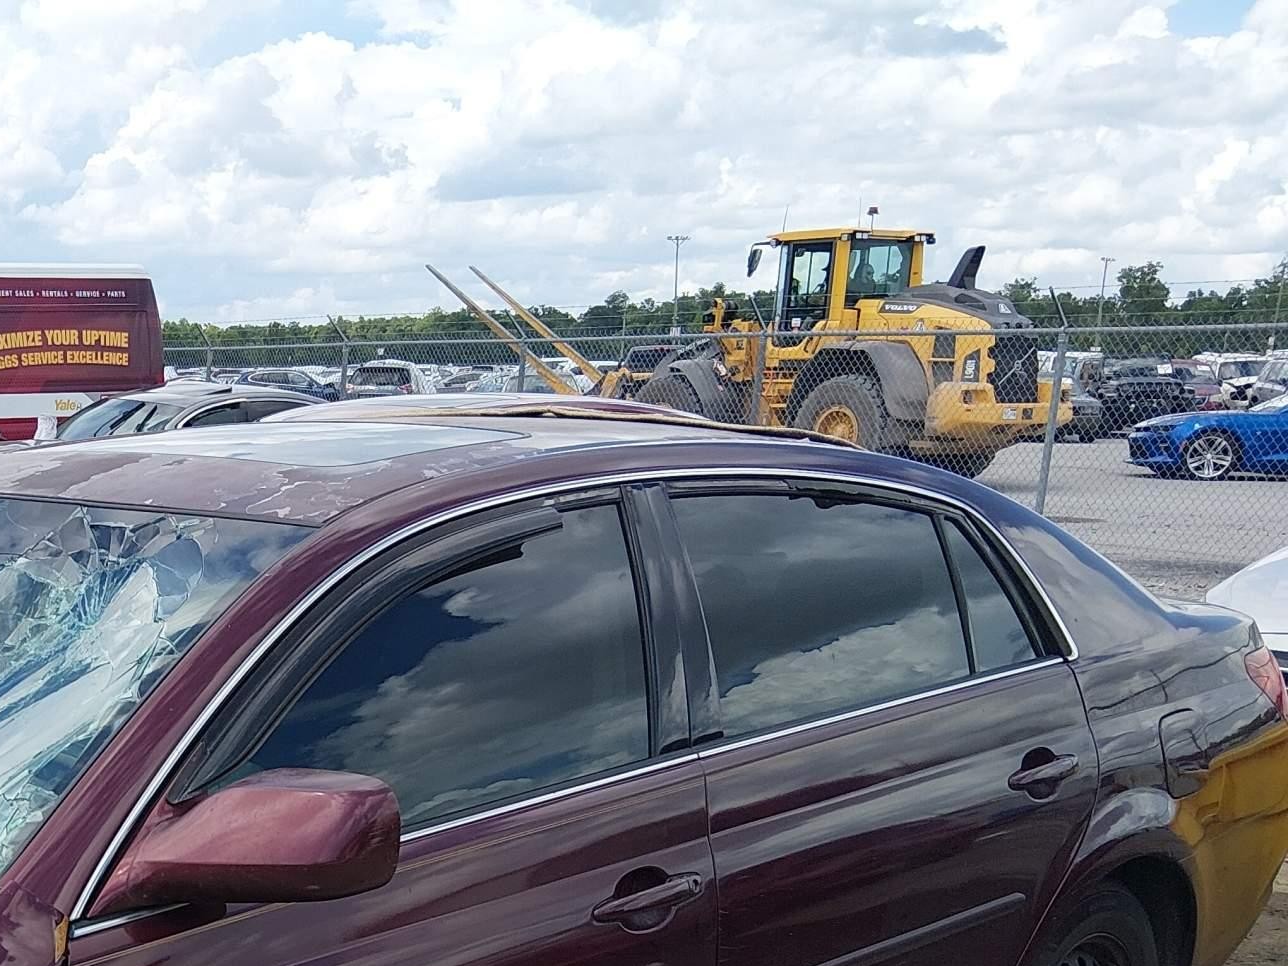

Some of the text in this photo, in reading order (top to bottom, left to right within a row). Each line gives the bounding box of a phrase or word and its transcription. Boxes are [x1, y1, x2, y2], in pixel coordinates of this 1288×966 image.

[44, 330, 79, 346] YOUR
[82, 330, 129, 347] UPTIME
[21, 351, 64, 367] SERVICE
[66, 351, 129, 366] EXCELLENCE
[55, 399, 76, 411] Yale
